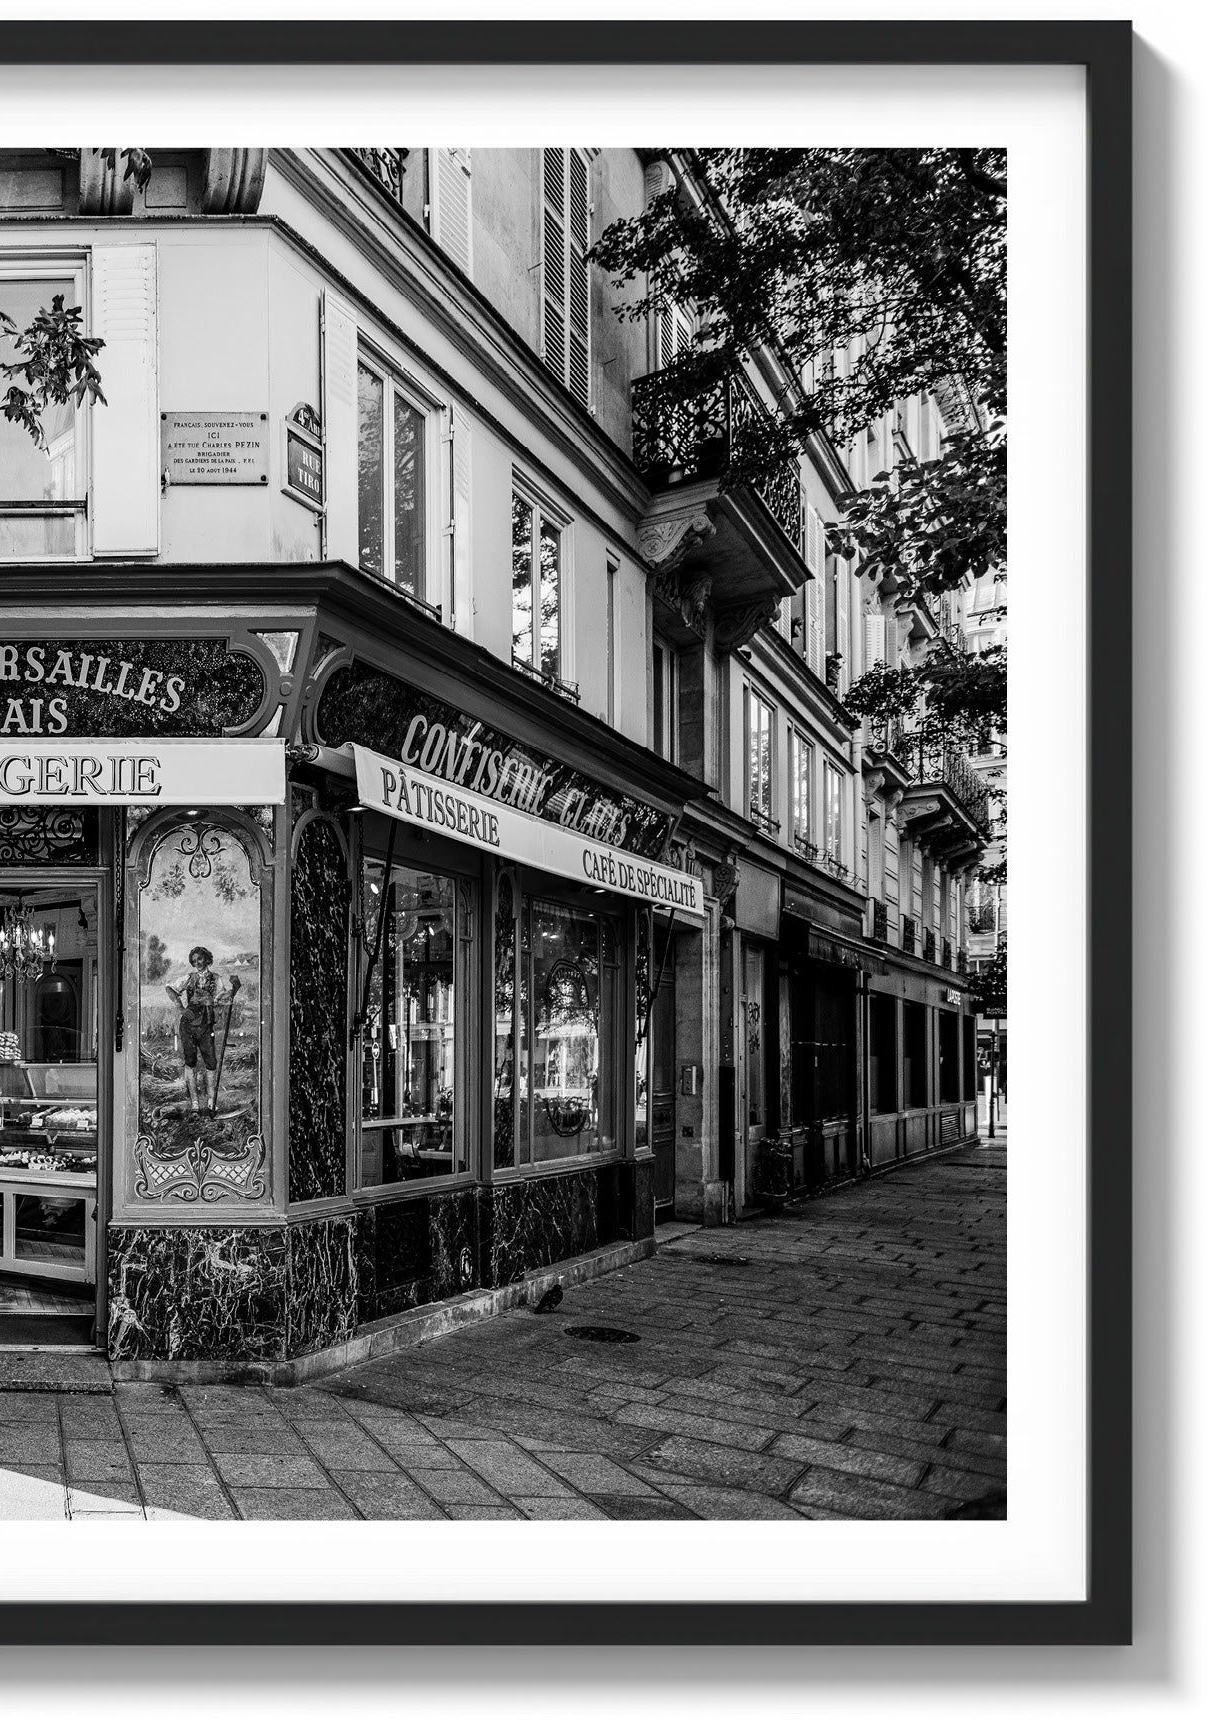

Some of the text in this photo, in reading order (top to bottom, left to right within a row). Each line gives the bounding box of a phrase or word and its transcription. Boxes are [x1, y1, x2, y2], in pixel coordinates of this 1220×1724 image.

[298, 467, 321, 495] TIRO
[302, 450, 321, 475] RUE
[380, 766, 501, 847] PÂTISSERIE
[400, 714, 632, 847] CONFISERIE GLACES
[582, 848, 697, 908] CAFÉ DE SPÉCIALITÉ
